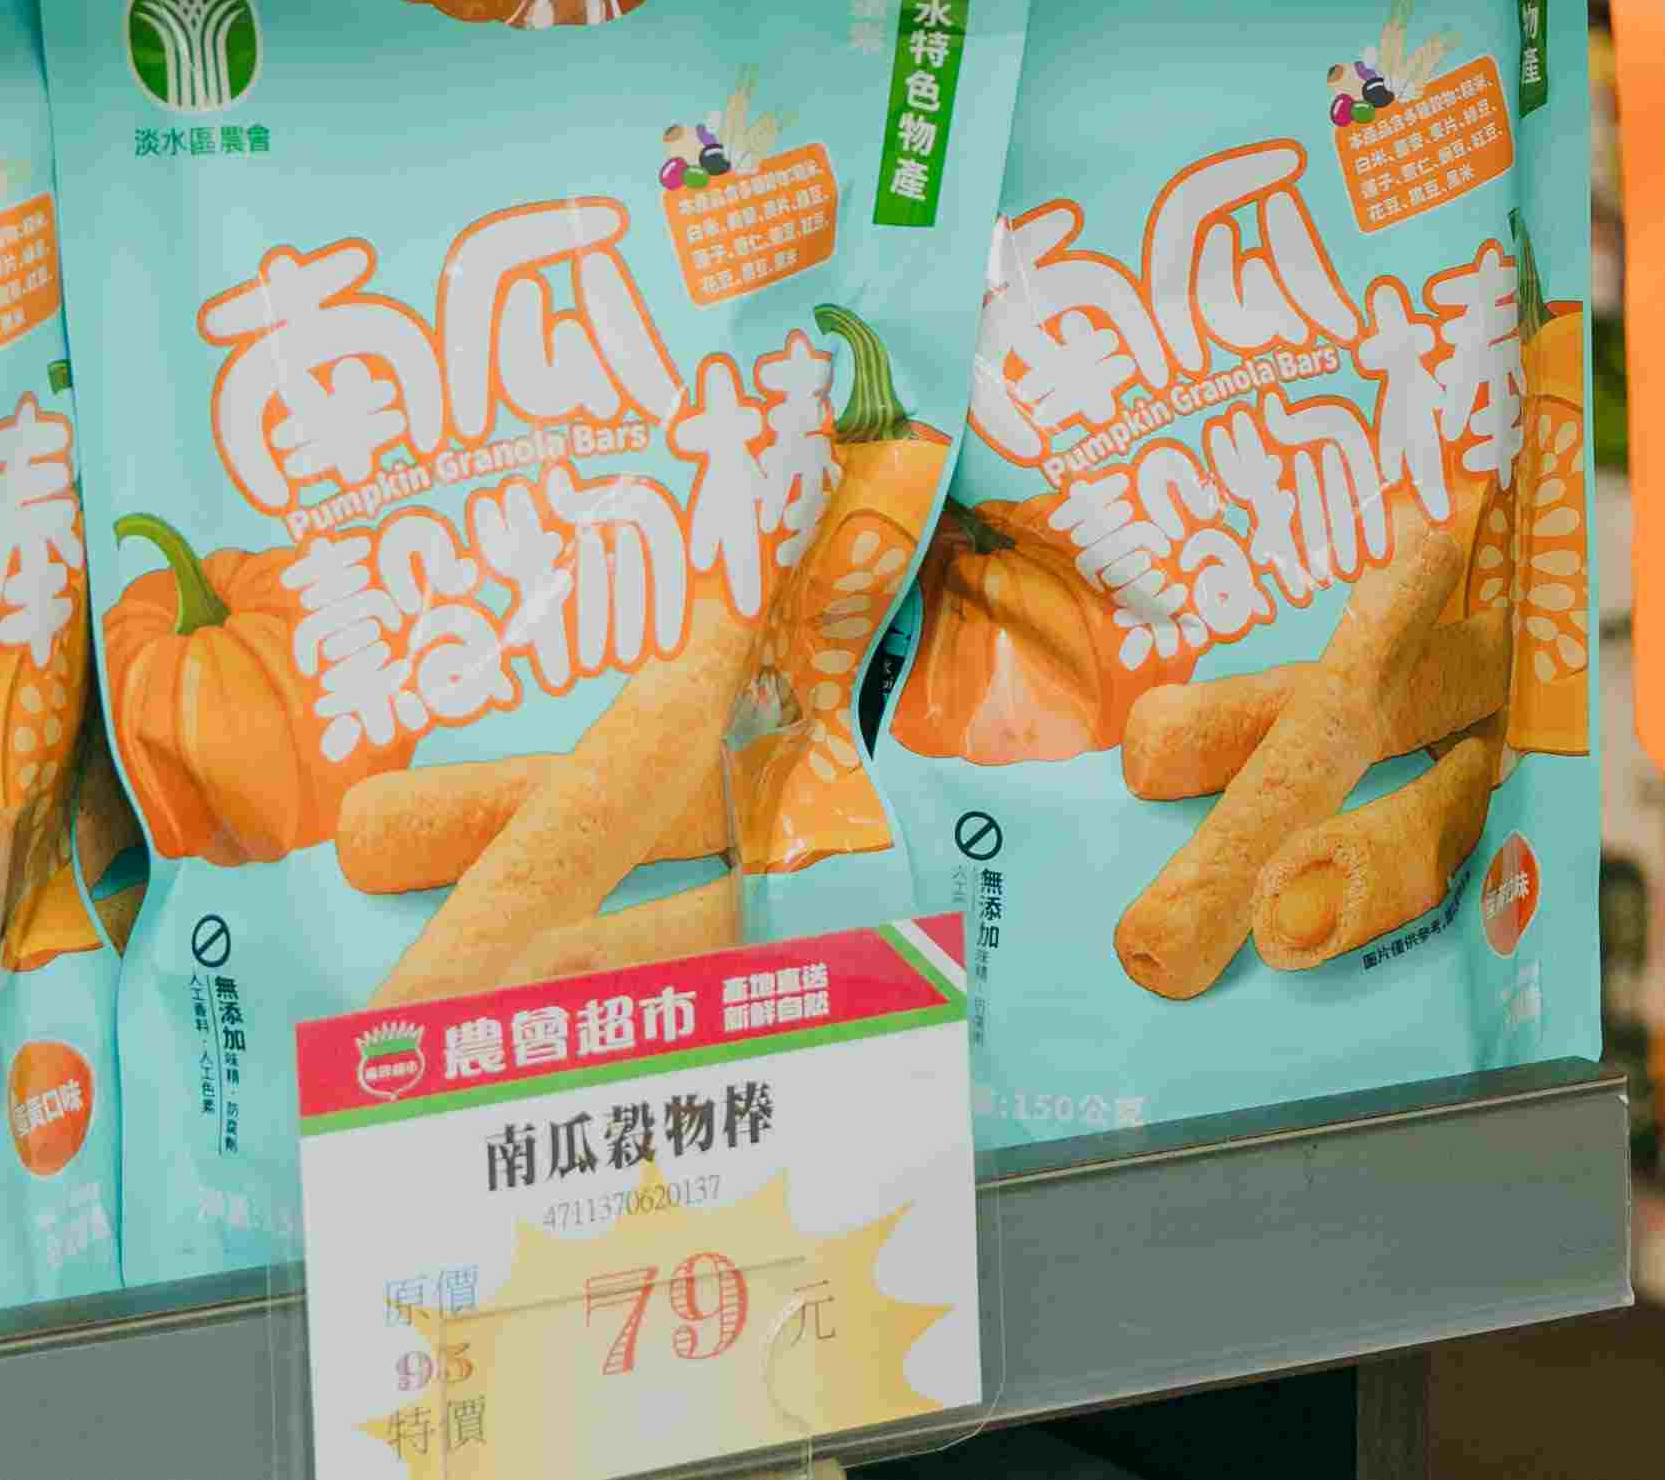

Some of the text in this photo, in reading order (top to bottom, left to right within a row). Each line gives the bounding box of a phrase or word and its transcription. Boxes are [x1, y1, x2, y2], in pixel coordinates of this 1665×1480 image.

[132, 123, 272, 158] 淡水區農會
[195, 193, 681, 517] 南瓜
[1043, 345, 1341, 487] Pumpkin Granola Bars
[285, 417, 651, 543] Pumpkin Granola Bars
[443, 985, 698, 1081] 農會超市
[485, 1079, 775, 1192] 南瓜穀物棒
[541, 1174, 723, 1232] 4711370620137
[381, 1264, 481, 1327] 原價
[583, 1248, 837, 1377] 79 元
[385, 1397, 489, 1463] 特價
